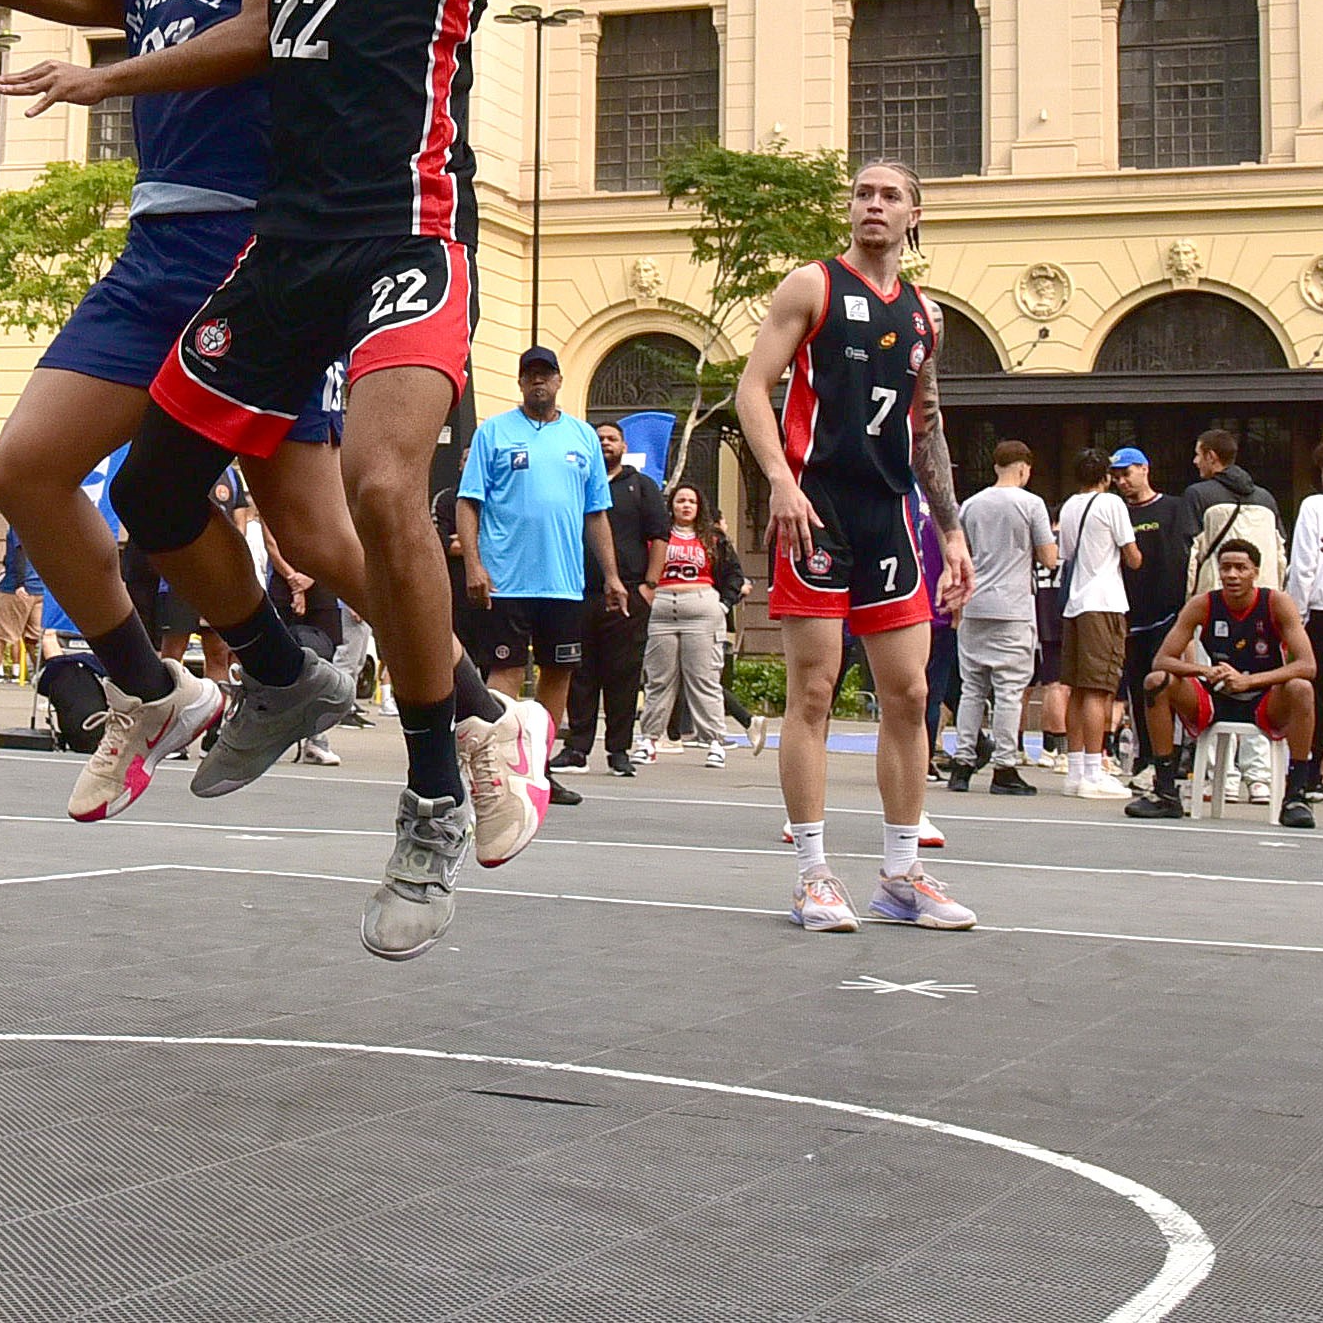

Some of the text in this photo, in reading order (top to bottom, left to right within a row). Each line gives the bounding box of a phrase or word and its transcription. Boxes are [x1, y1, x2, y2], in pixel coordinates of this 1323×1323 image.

[368, 268, 428, 324] 22
[866, 386, 897, 436] 7
[666, 544, 705, 568] ULLS
[880, 556, 897, 593] 7
